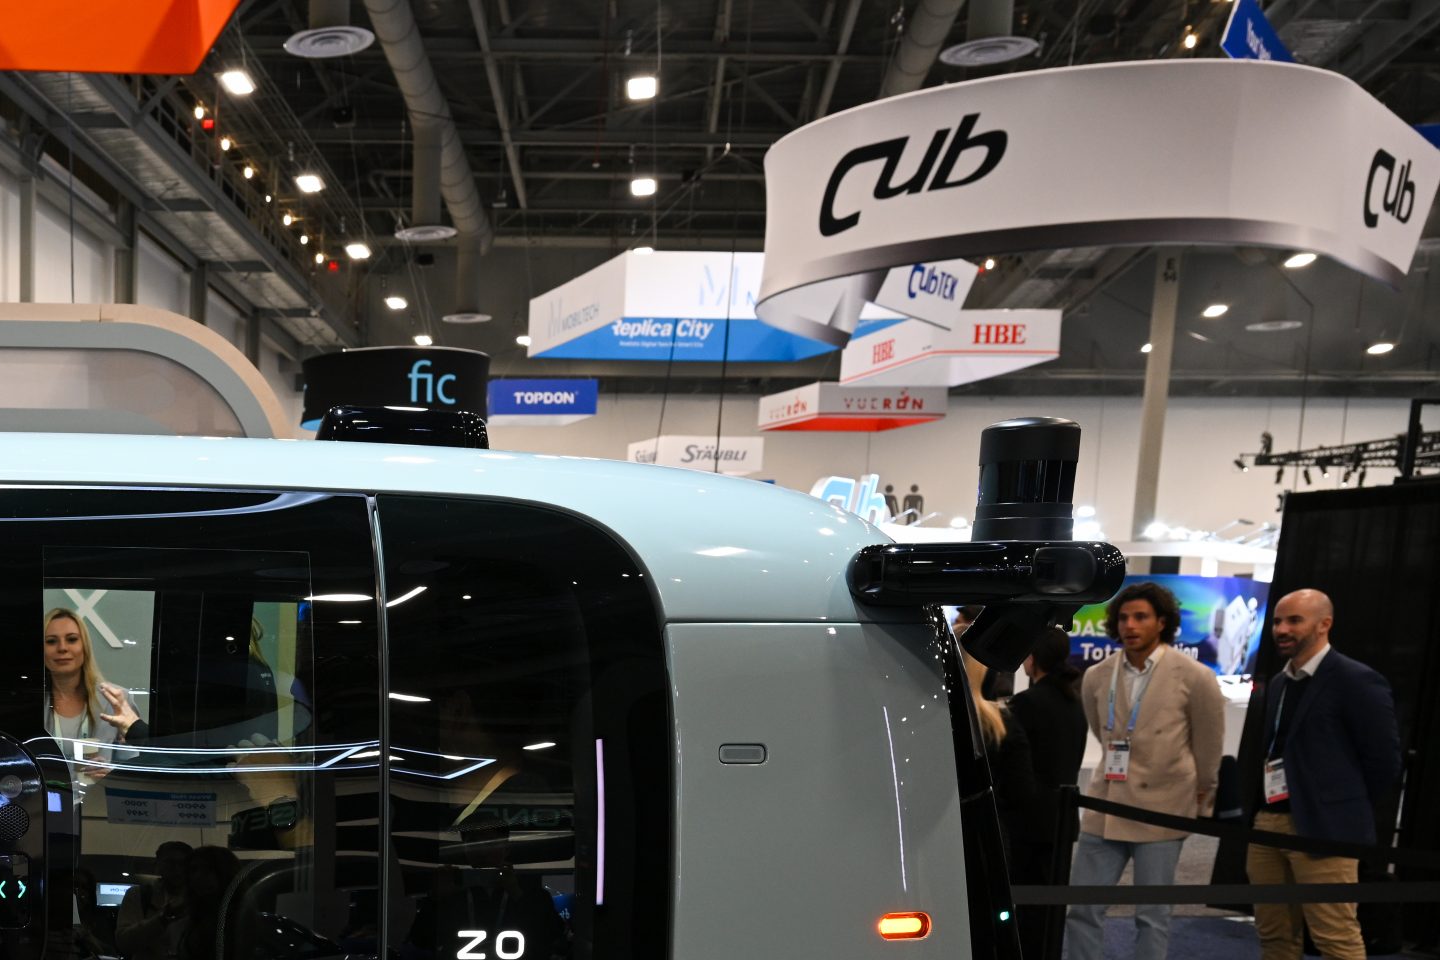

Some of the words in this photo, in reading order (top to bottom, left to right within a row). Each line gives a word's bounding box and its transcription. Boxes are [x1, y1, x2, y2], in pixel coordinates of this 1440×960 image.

[676, 318, 713, 340] City
[972, 323, 1027, 345] HBE
[871, 338, 896, 365] HBE
[407, 359, 457, 405] fic
[513, 391, 575, 405] TOPDON
